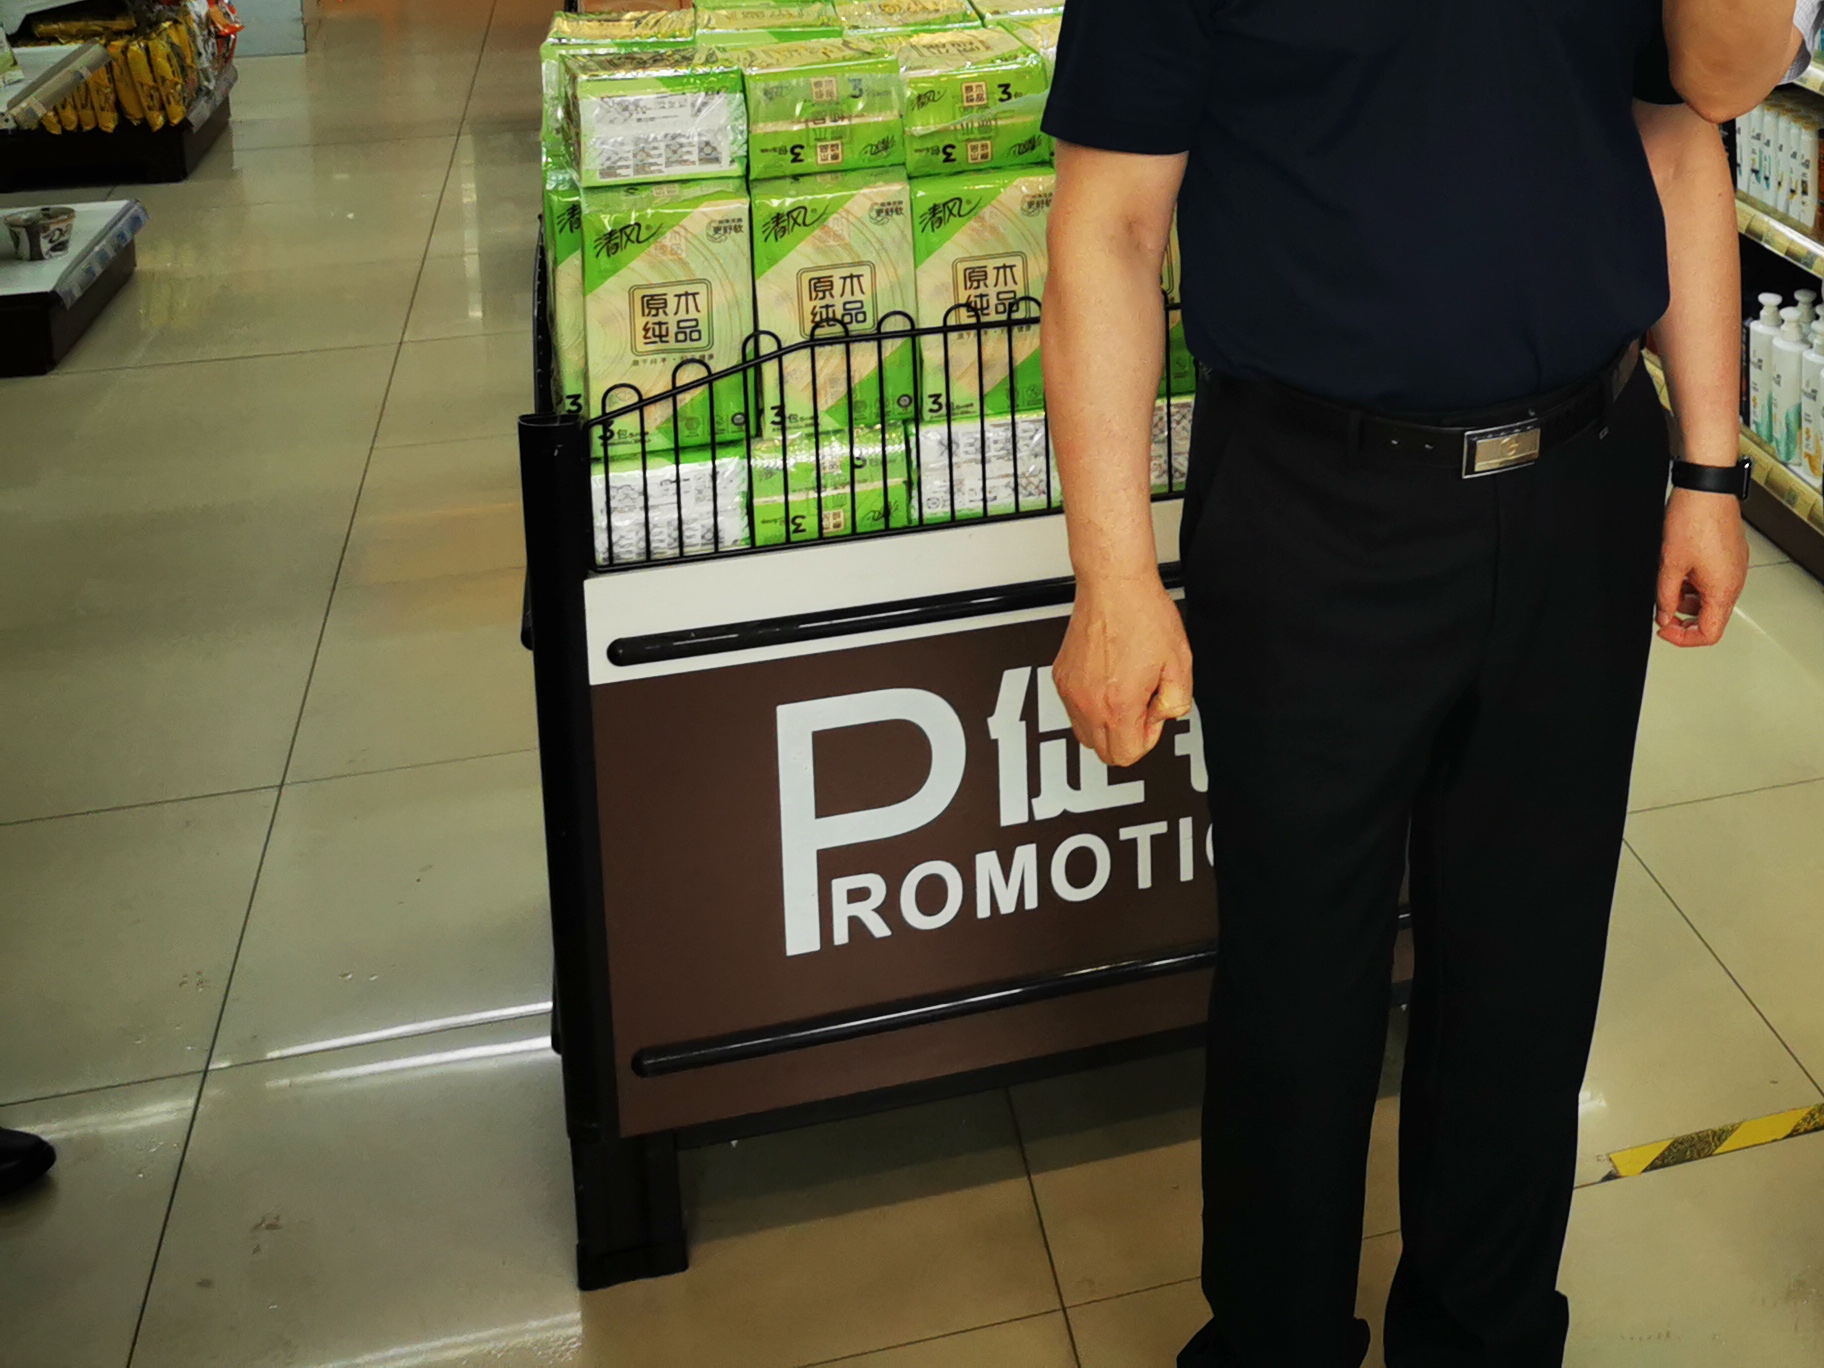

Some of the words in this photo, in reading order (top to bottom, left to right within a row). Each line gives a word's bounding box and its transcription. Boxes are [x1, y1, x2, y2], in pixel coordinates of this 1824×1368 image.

[762, 203, 830, 243] 清风
[918, 196, 984, 234] 清风
[593, 221, 665, 259] 清风
[808, 272, 866, 302] 原木
[963, 263, 1019, 291] 原木
[640, 290, 702, 317] 原木
[641, 318, 703, 345] 纯品
[776, 687, 1214, 958] PROMOTI
